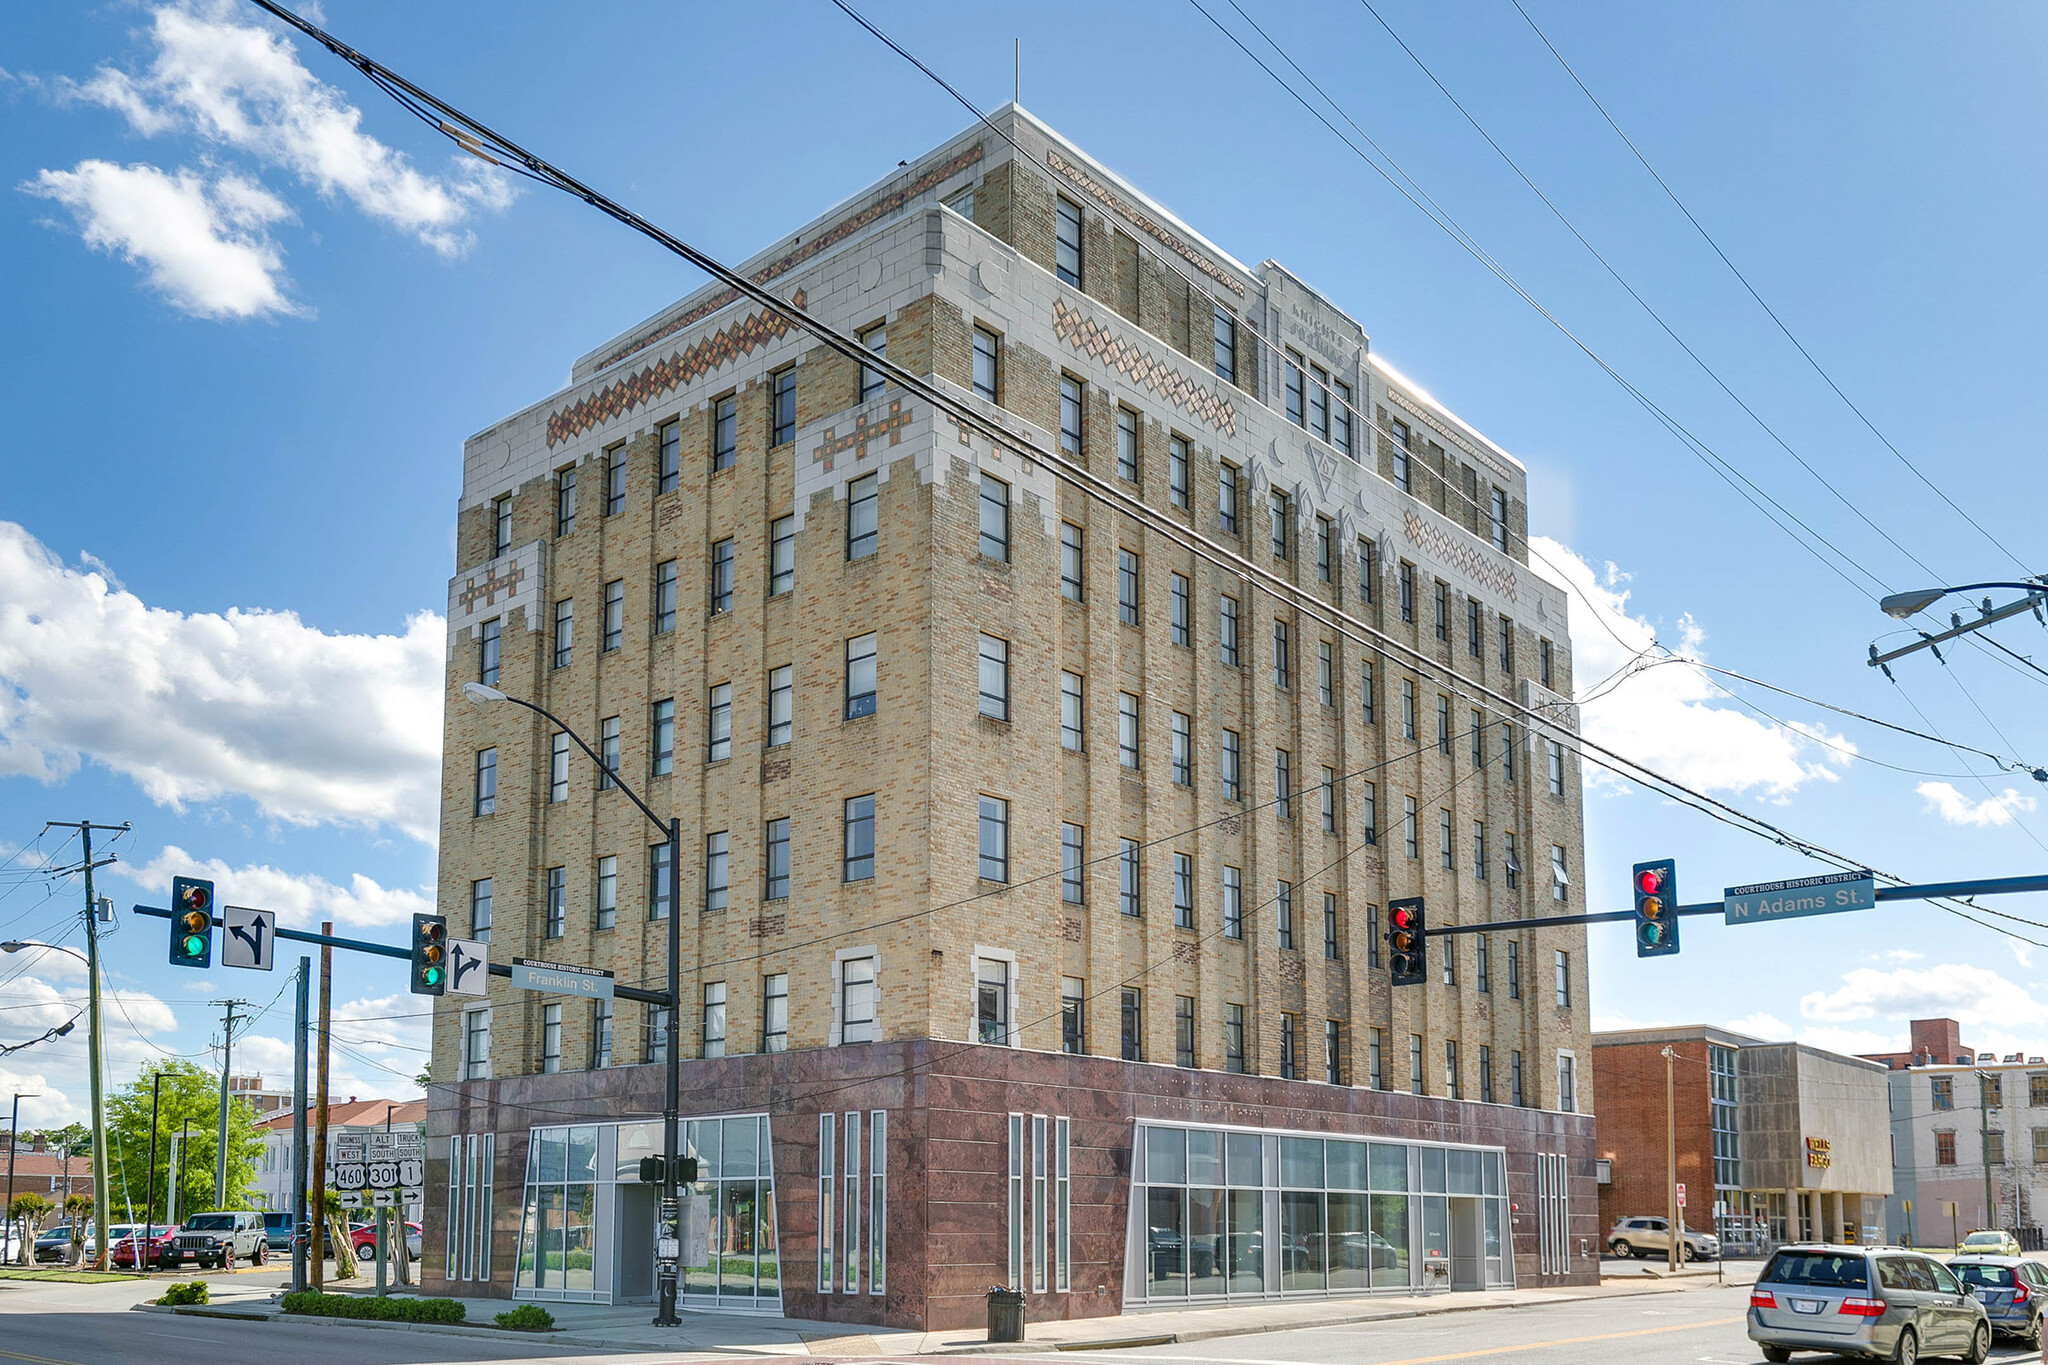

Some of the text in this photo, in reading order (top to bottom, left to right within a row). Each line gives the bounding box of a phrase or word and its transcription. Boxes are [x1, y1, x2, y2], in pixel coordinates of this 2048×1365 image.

[1734, 872, 1863, 896] COURTHOUSE HISTORIC DISTRICT
[1735, 888, 1865, 918] N Adams St.
[523, 959, 604, 977] COURTHOUSE HISTORIC DISTRICT
[528, 971, 598, 992] Franklin St.
[340, 1136, 361, 1144] BUSINESS
[375, 1135, 390, 1143] ALT
[399, 1134, 420, 1142] TRUCK
[341, 1151, 360, 1159] WEST
[371, 1150, 394, 1158] SOUTH
[399, 1147, 420, 1156] SOUTH
[340, 1169, 362, 1184] 460
[371, 1168, 395, 1183] 301
[408, 1166, 413, 1181] 1
